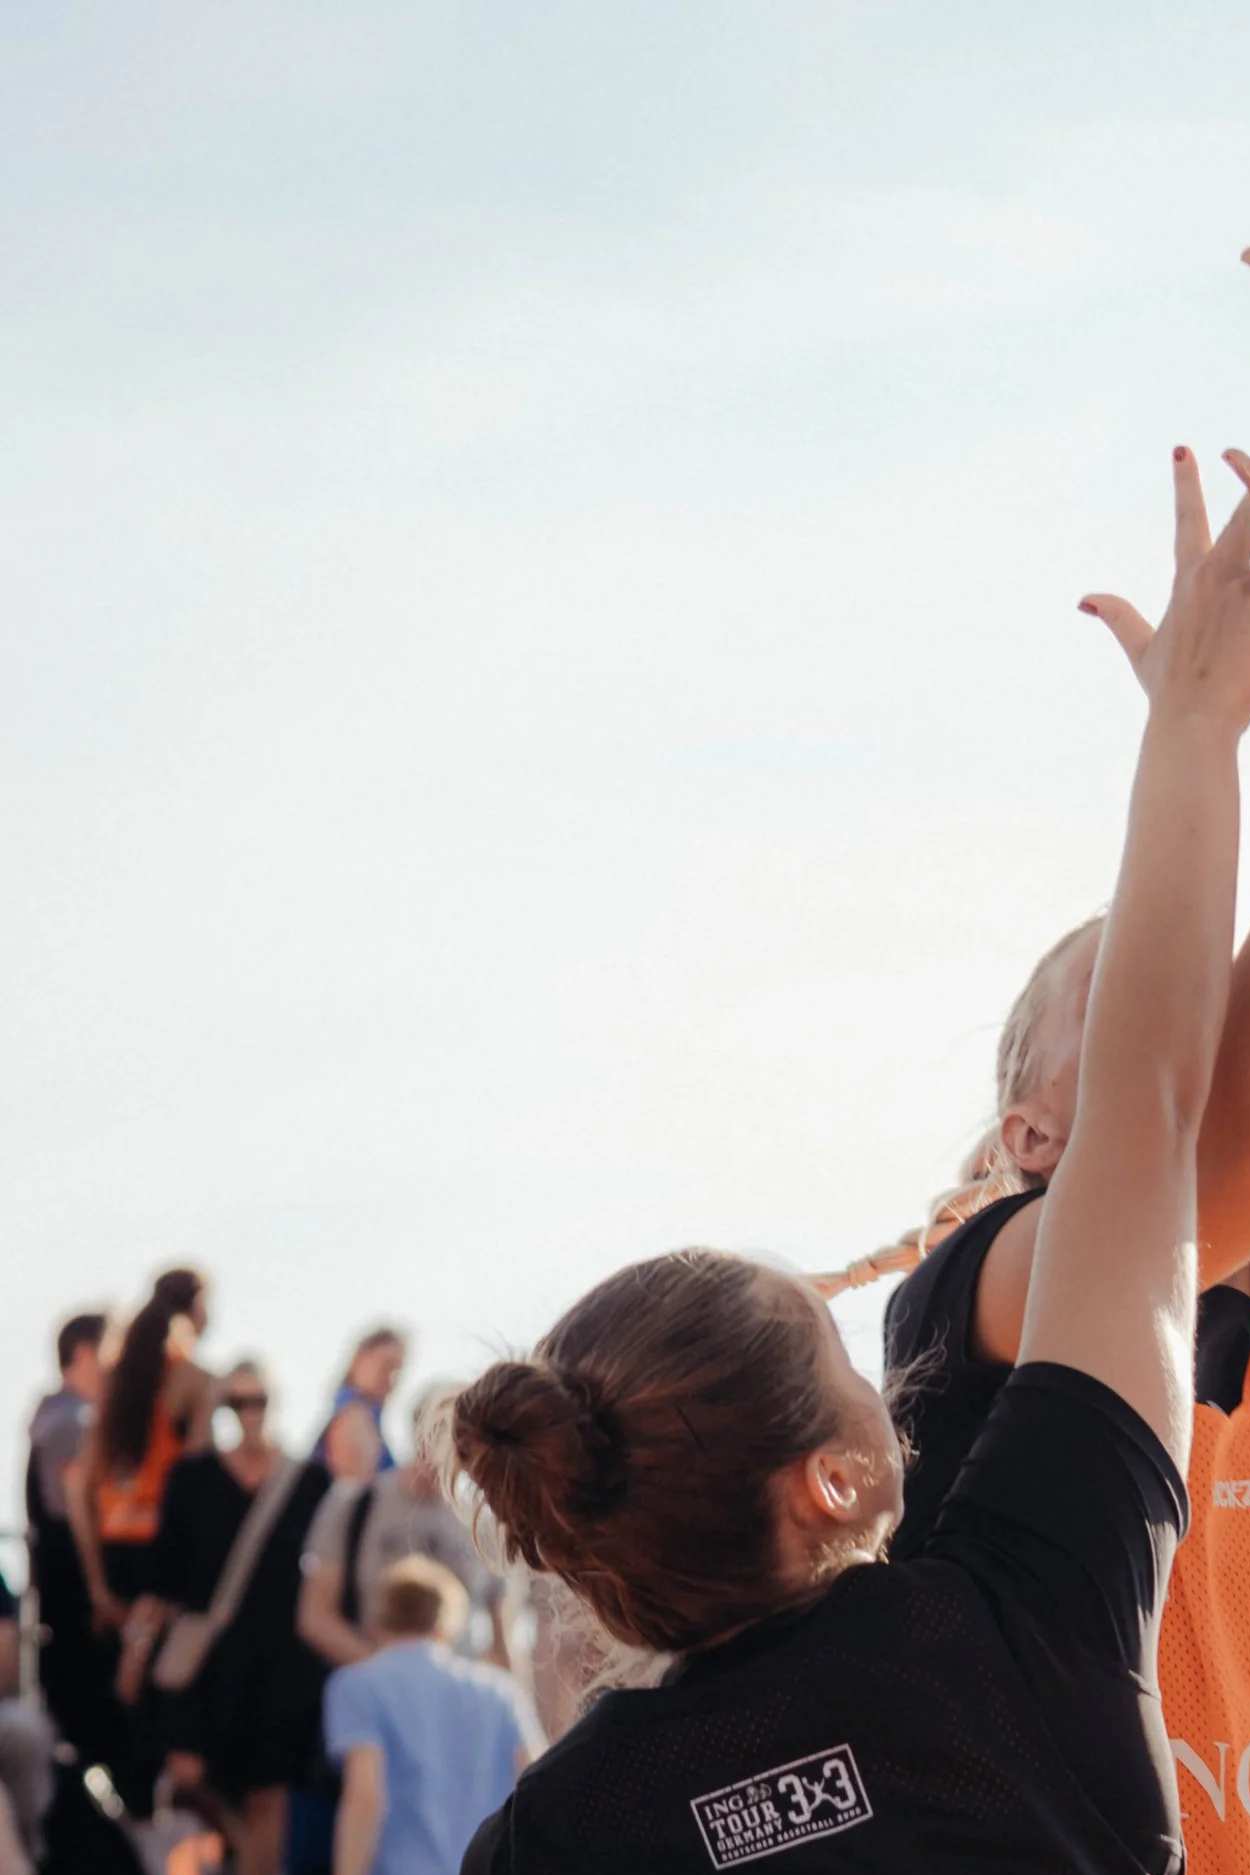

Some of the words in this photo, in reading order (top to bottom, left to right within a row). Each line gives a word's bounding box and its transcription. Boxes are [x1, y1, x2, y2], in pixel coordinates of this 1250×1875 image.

[704, 1795, 743, 1821] ING
[710, 1801, 781, 1838] TOUR
[717, 1818, 783, 1852] GERMANY
[777, 1818, 834, 1842] BASKETBALL
